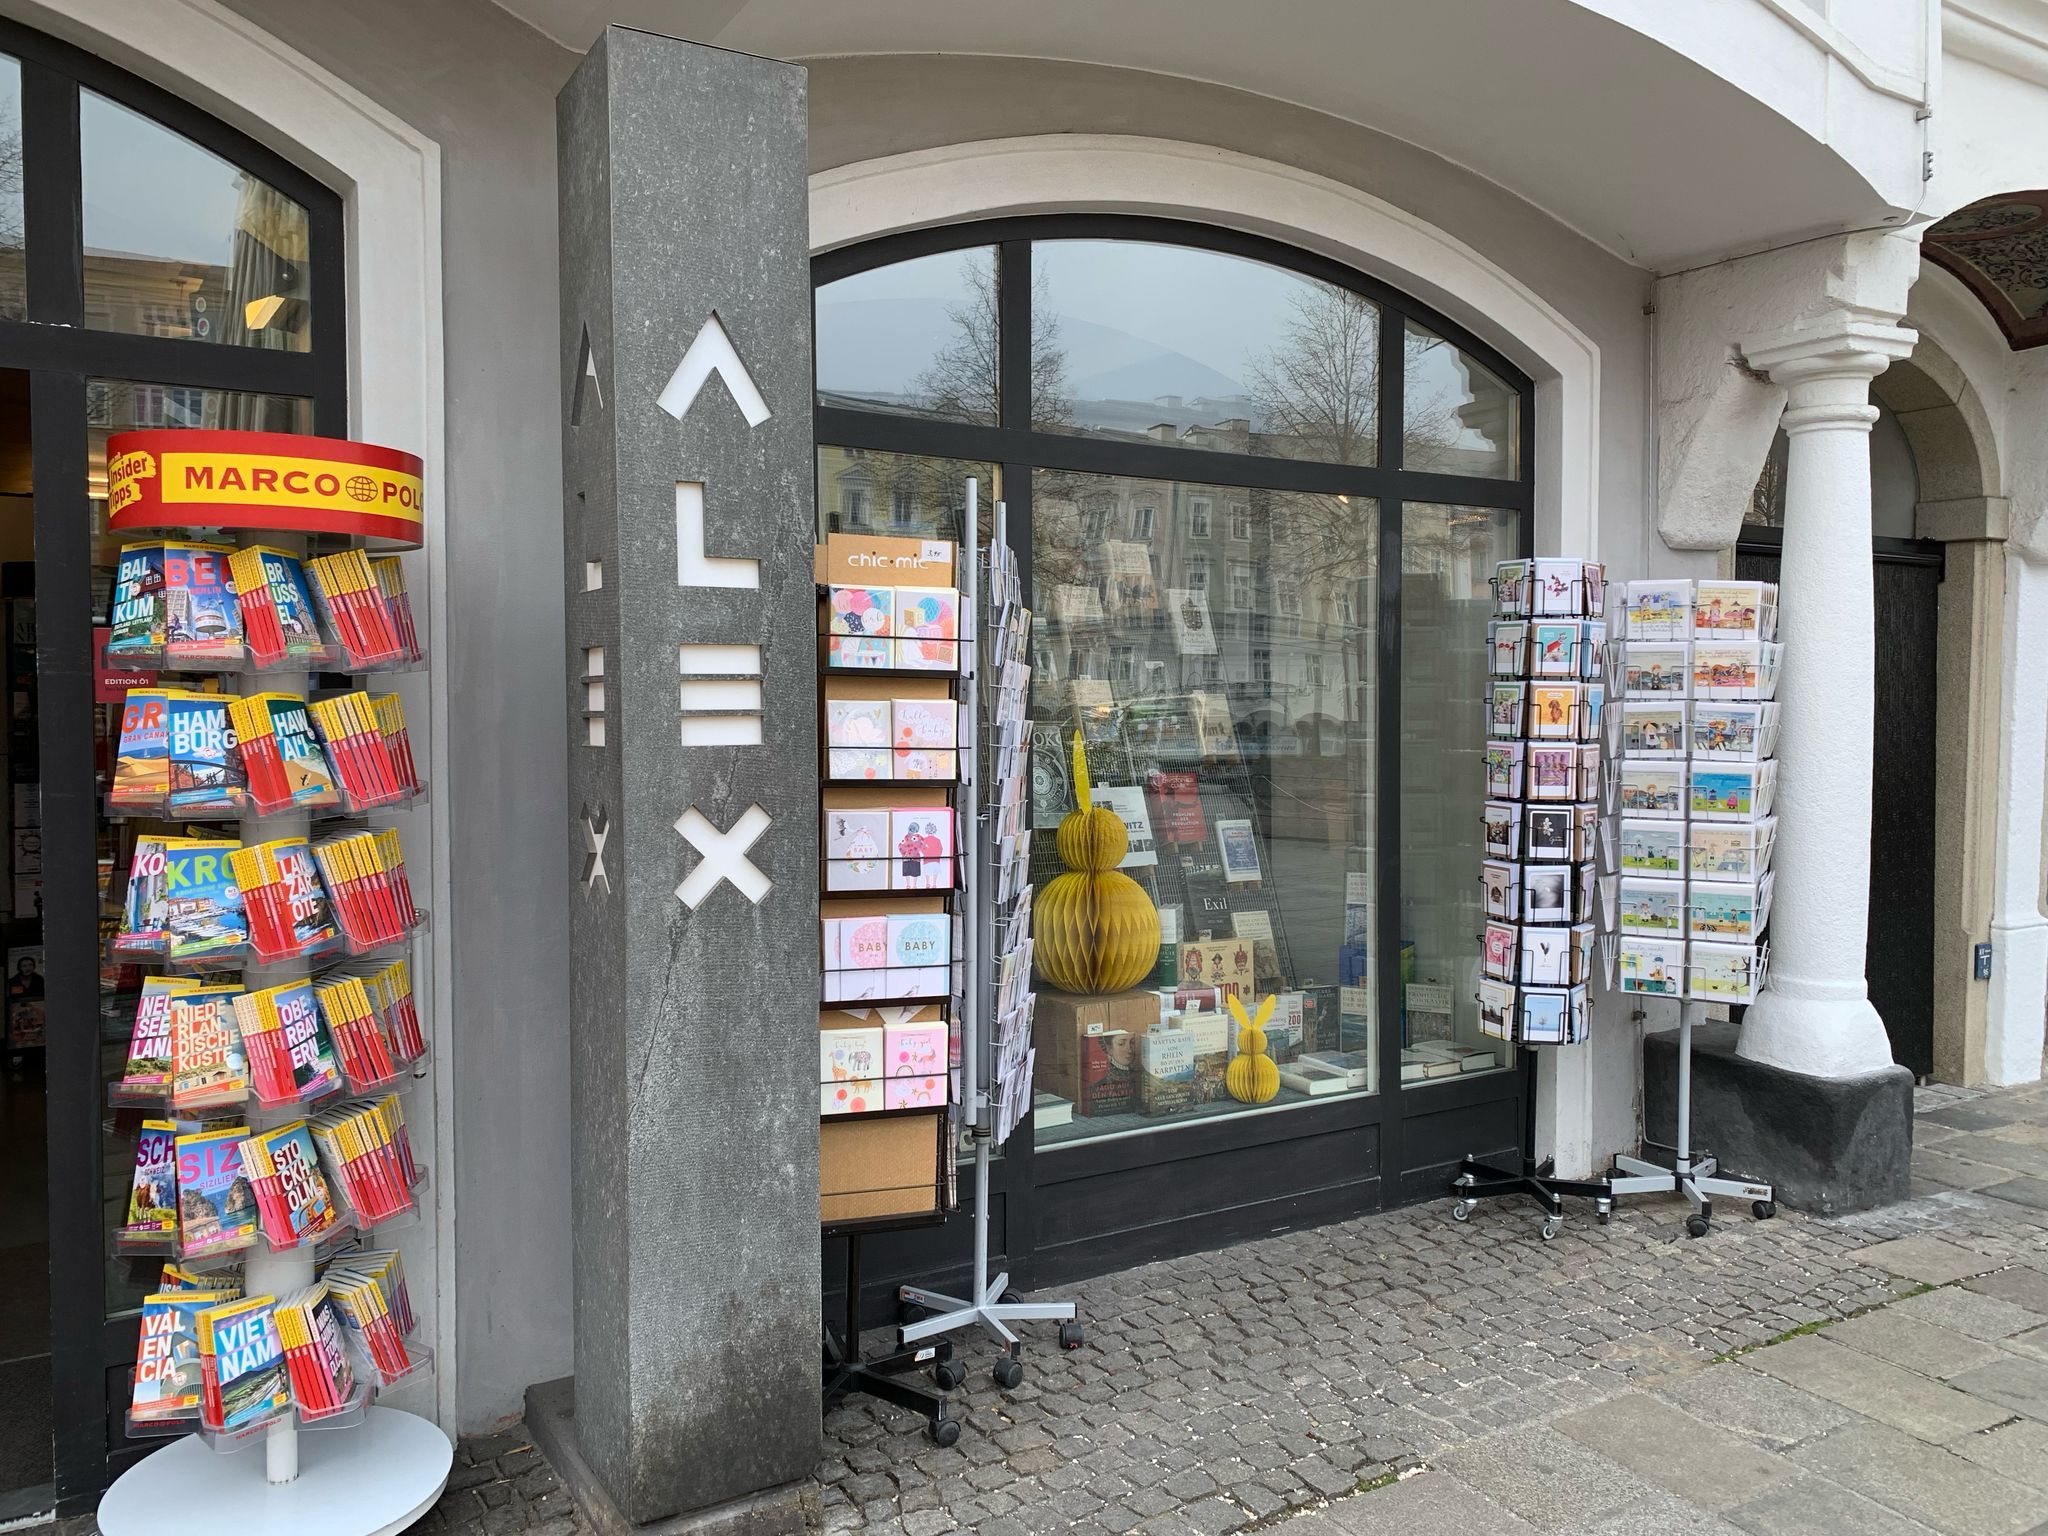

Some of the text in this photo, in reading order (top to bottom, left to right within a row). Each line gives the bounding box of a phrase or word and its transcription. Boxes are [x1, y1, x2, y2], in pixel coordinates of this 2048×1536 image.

[185, 466, 340, 496] MARCO
[120, 556, 151, 583] BAL
[265, 562, 286, 583] BR
[272, 582, 299, 604] ÜSS
[115, 595, 154, 624] KUM
[278, 604, 295, 625] EL
[122, 701, 168, 734] GR
[173, 708, 226, 734] HAM
[274, 708, 308, 738] HAW
[174, 728, 238, 755] BURG
[134, 852, 168, 878] KO
[291, 898, 320, 922] OTE
[1203, 897, 1228, 911] Exil
[904, 940, 936, 951] BABY
[176, 999, 226, 1024] NIEDE
[281, 994, 310, 1026] OBE
[1288, 1014, 1302, 1026] 200
[137, 1014, 170, 1039] SEE
[285, 1009, 319, 1049] RBAY
[179, 1027, 240, 1057] DISCHE
[290, 1036, 320, 1069] ERN
[1161, 1051, 1184, 1060] RHEIN
[1154, 1064, 1191, 1075] KARPATEN
[178, 1140, 241, 1185] SIZ
[273, 1138, 301, 1171] STO
[144, 1166, 166, 1176] SCHWEIZ
[199, 1173, 237, 1190] SIZILIEN
[280, 1156, 311, 1191] CKH
[287, 1176, 319, 1212] OLM
[145, 1310, 186, 1337] VAL
[218, 1308, 271, 1353] VIET
[142, 1335, 173, 1360] EN
[221, 1334, 277, 1381] NAM
[139, 1356, 177, 1383] CIA
